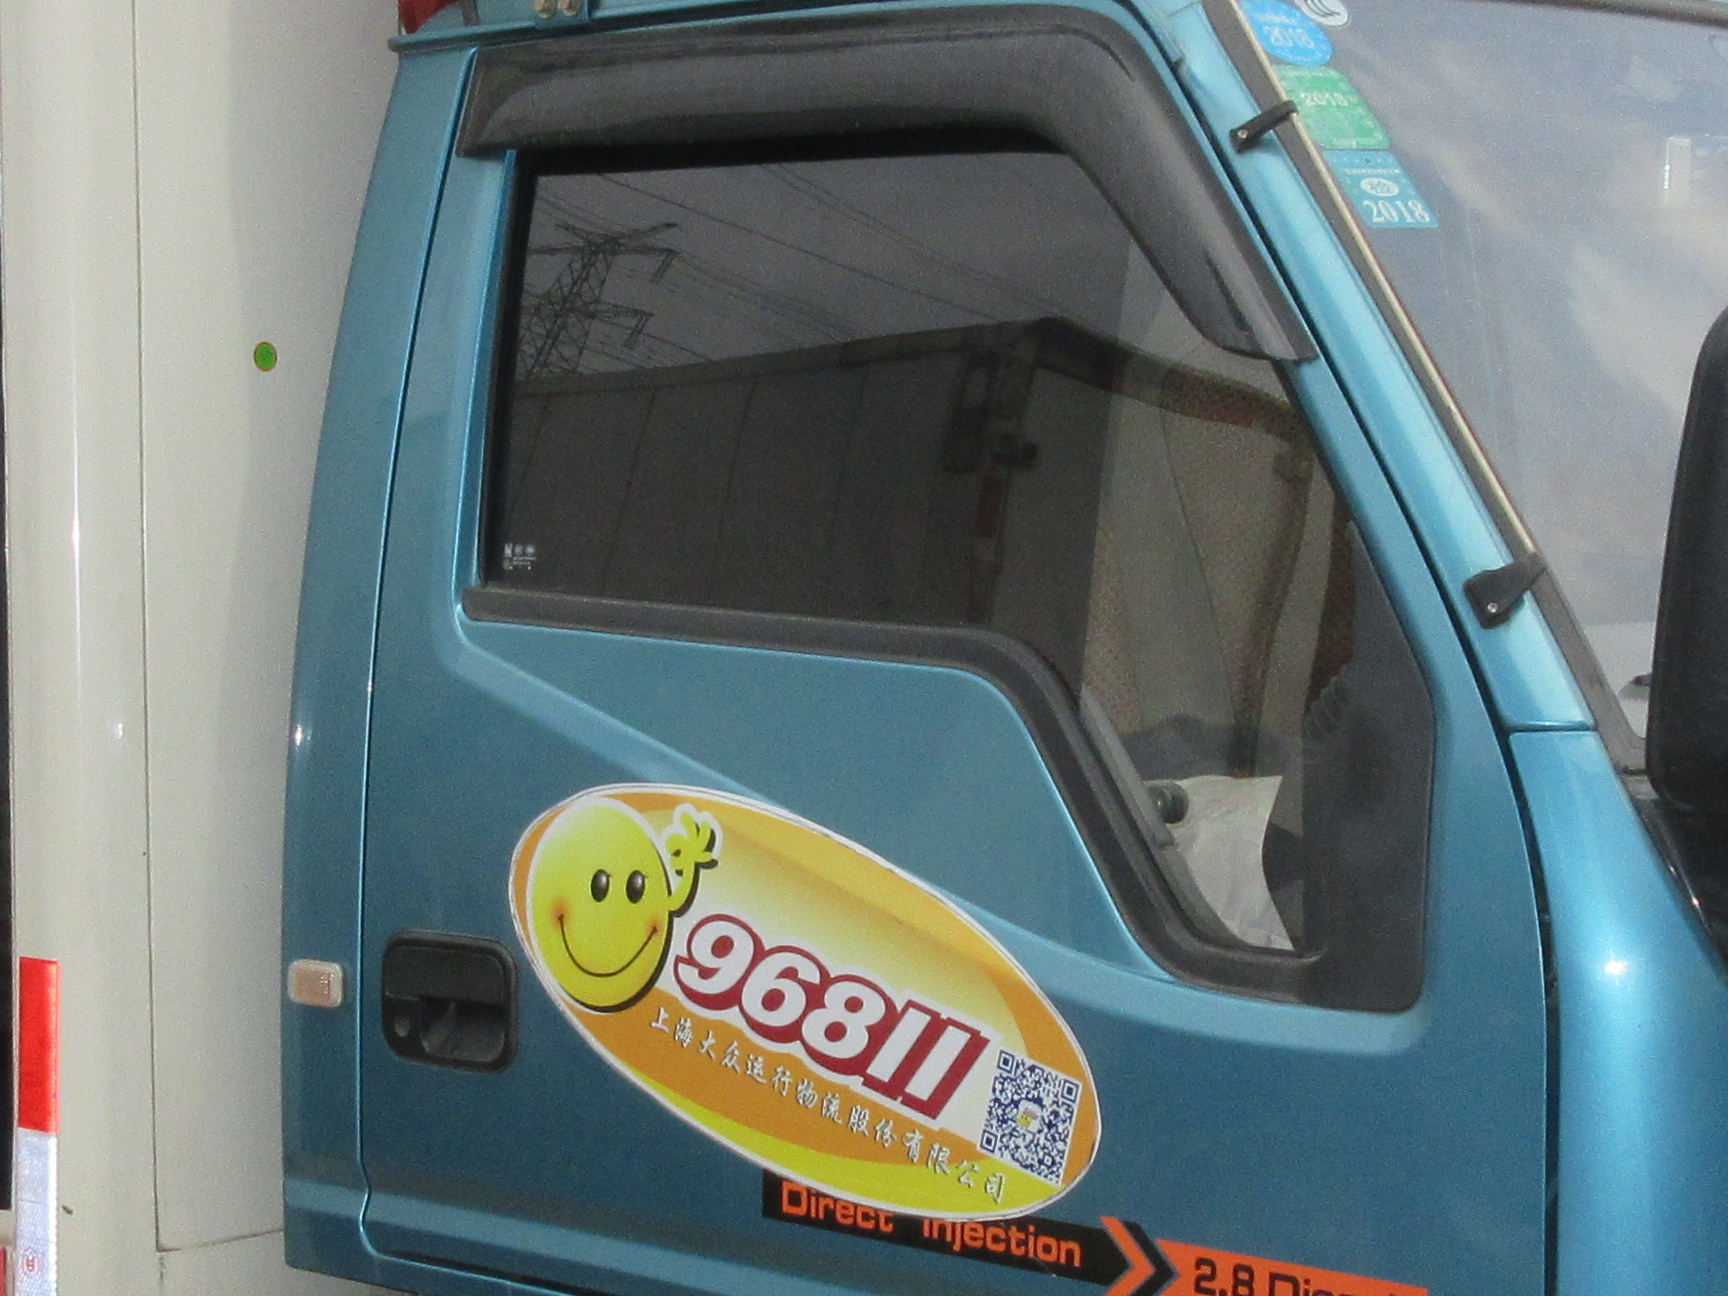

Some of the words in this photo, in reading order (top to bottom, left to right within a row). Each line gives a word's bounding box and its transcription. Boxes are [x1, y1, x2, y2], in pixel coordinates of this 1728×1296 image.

[1363, 201, 1430, 223] 2018
[674, 913, 988, 1118] 96811
[649, 1006, 1007, 1205] 上海大众运行物流股份有限公司
[780, 1180, 894, 1234] Direct
